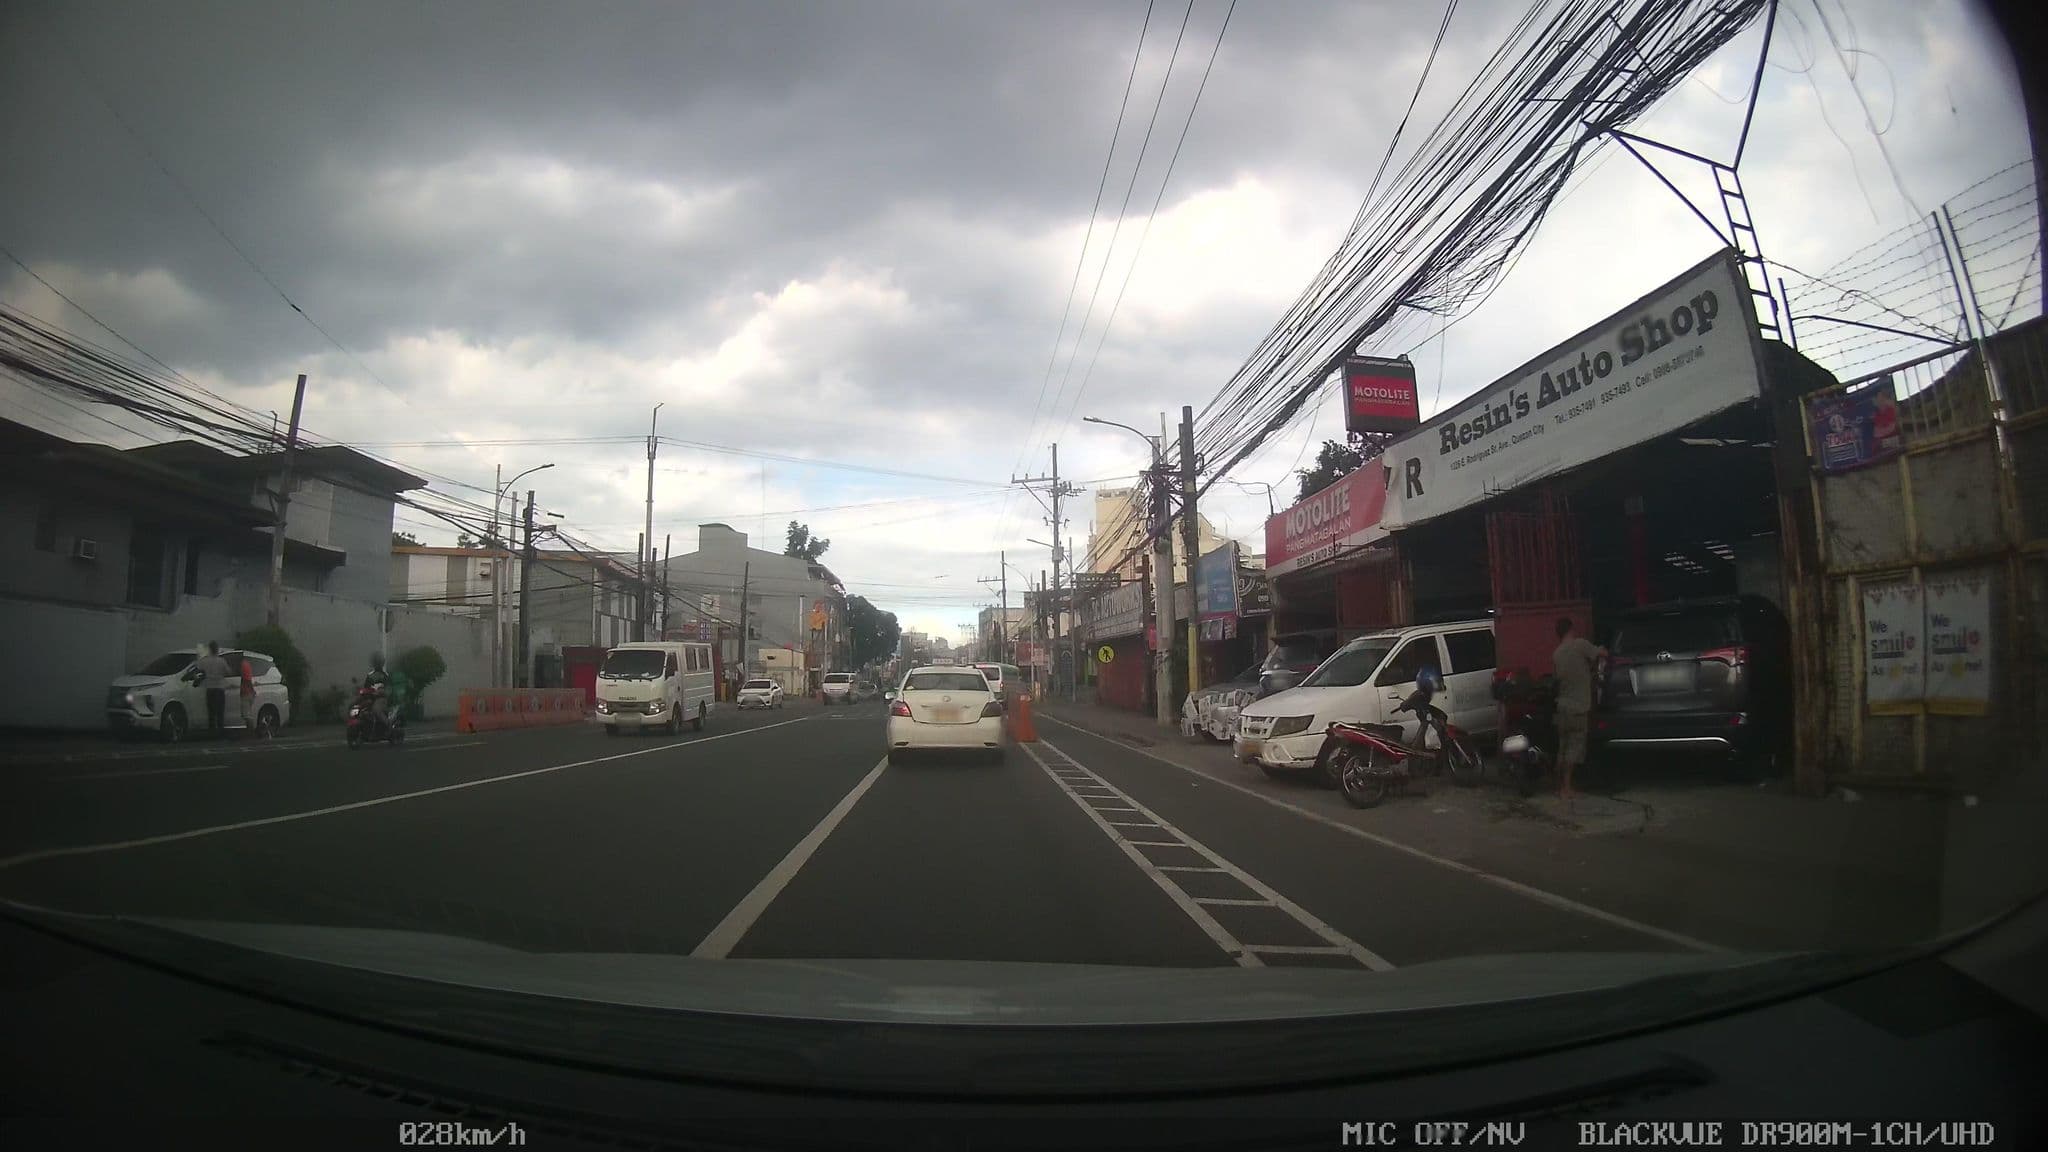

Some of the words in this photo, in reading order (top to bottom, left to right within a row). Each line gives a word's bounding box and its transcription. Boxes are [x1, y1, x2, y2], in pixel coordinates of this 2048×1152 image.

[1439, 389, 1530, 454] Resin's
[1536, 351, 1613, 409] Auto
[1618, 290, 1719, 367] Shop
[1354, 386, 1410, 400] MOTOLITE
[1405, 457, 1425, 499] R
[1286, 485, 1350, 538] MOTOLITE
[1869, 620, 1888, 633] We
[1930, 613, 1951, 627] We
[1871, 630, 1915, 652] smile
[1932, 626, 1980, 648] smile
